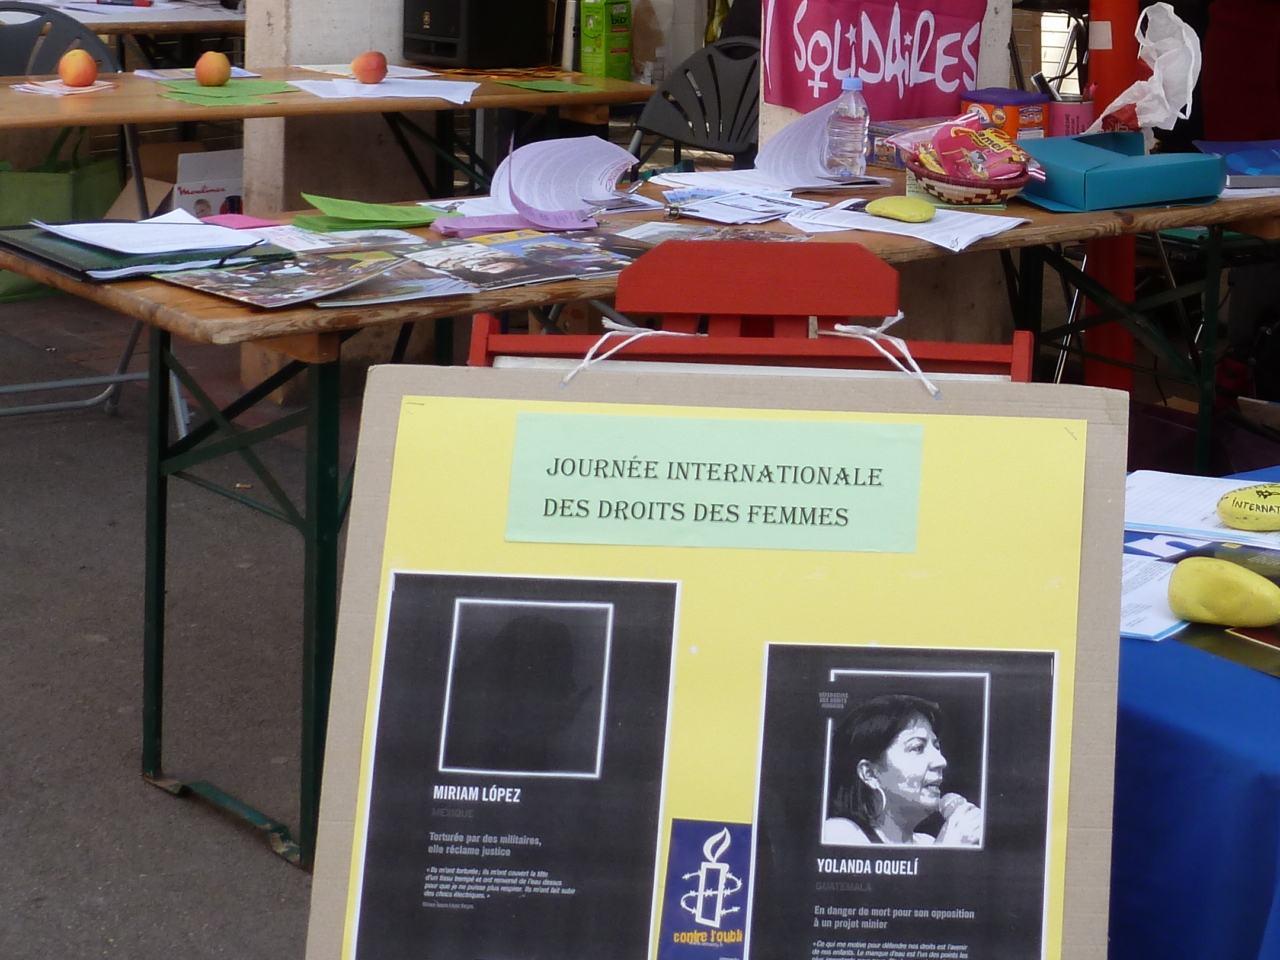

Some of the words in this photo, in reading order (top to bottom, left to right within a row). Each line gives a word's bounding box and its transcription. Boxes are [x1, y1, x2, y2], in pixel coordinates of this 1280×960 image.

[546, 456, 659, 481] JOURNÉE
[667, 461, 884, 487] INTERNATIONALE
[543, 498, 590, 519] DES
[598, 500, 685, 521] DROITS
[693, 502, 740, 523] DES
[748, 504, 849, 527] FEMMES
[433, 785, 479, 801] MIRIAM
[482, 784, 521, 803] LÓPEZ
[431, 807, 474, 819] MEXIQUE
[429, 832, 464, 842] Torturée
[466, 835, 480, 844] par
[482, 834, 498, 843] des
[500, 835, 542, 846] militaires,
[428, 844, 444, 853] elle
[446, 845, 480, 855] réclame
[481, 846, 511, 857] justice
[817, 858, 871, 875] YOLANDA
[875, 858, 919, 875] OQUELÍ
[815, 881, 872, 892] GUATEMALA
[814, 905, 825, 915] En
[827, 906, 857, 918] danger
[858, 907, 869, 916] de
[871, 908, 891, 917] mort
[892, 910, 912, 918] pour
[913, 909, 928, 917] son
[931, 908, 974, 919] opposition
[813, 917, 819, 928] à
[822, 920, 832, 928] un
[834, 919, 859, 930] projet
[861, 918, 887, 929] minier
[673, 930, 707, 943] contre
[710, 929, 742, 943] l'oubli
